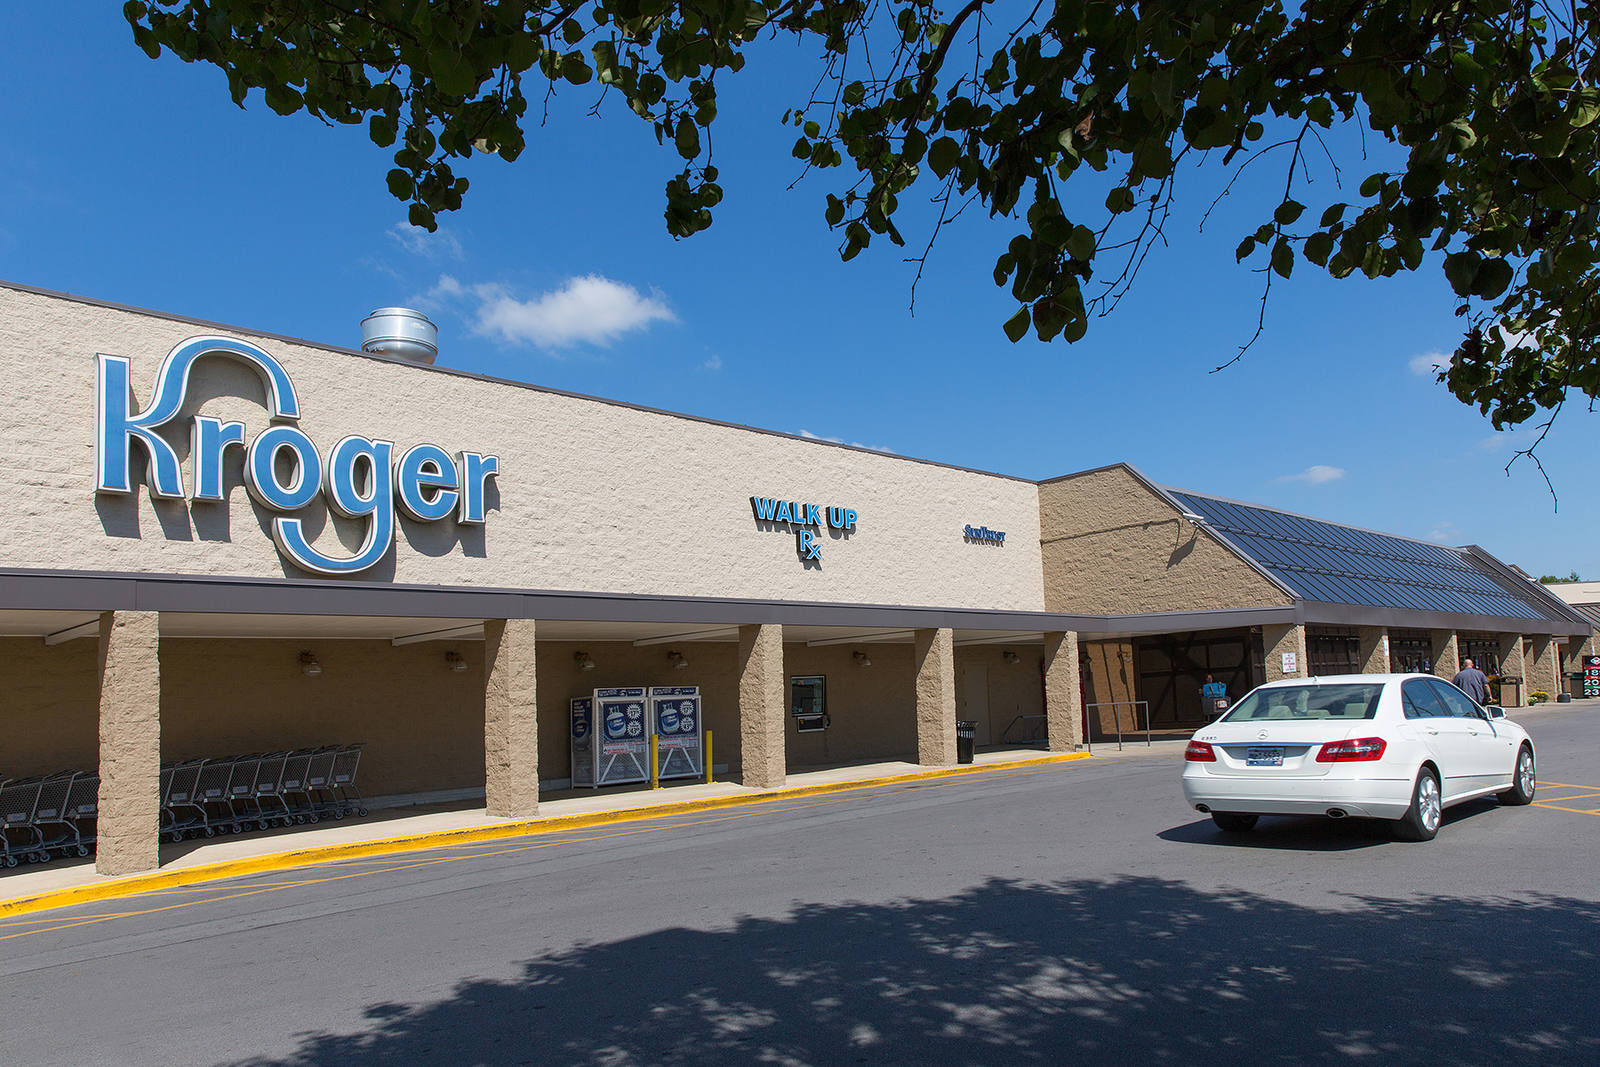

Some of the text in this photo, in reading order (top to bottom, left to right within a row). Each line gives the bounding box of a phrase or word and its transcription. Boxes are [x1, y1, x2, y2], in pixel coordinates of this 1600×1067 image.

[95, 335, 500, 574] Kroger
[752, 496, 858, 529] WALK UP
[798, 530, 823, 560] Rx
